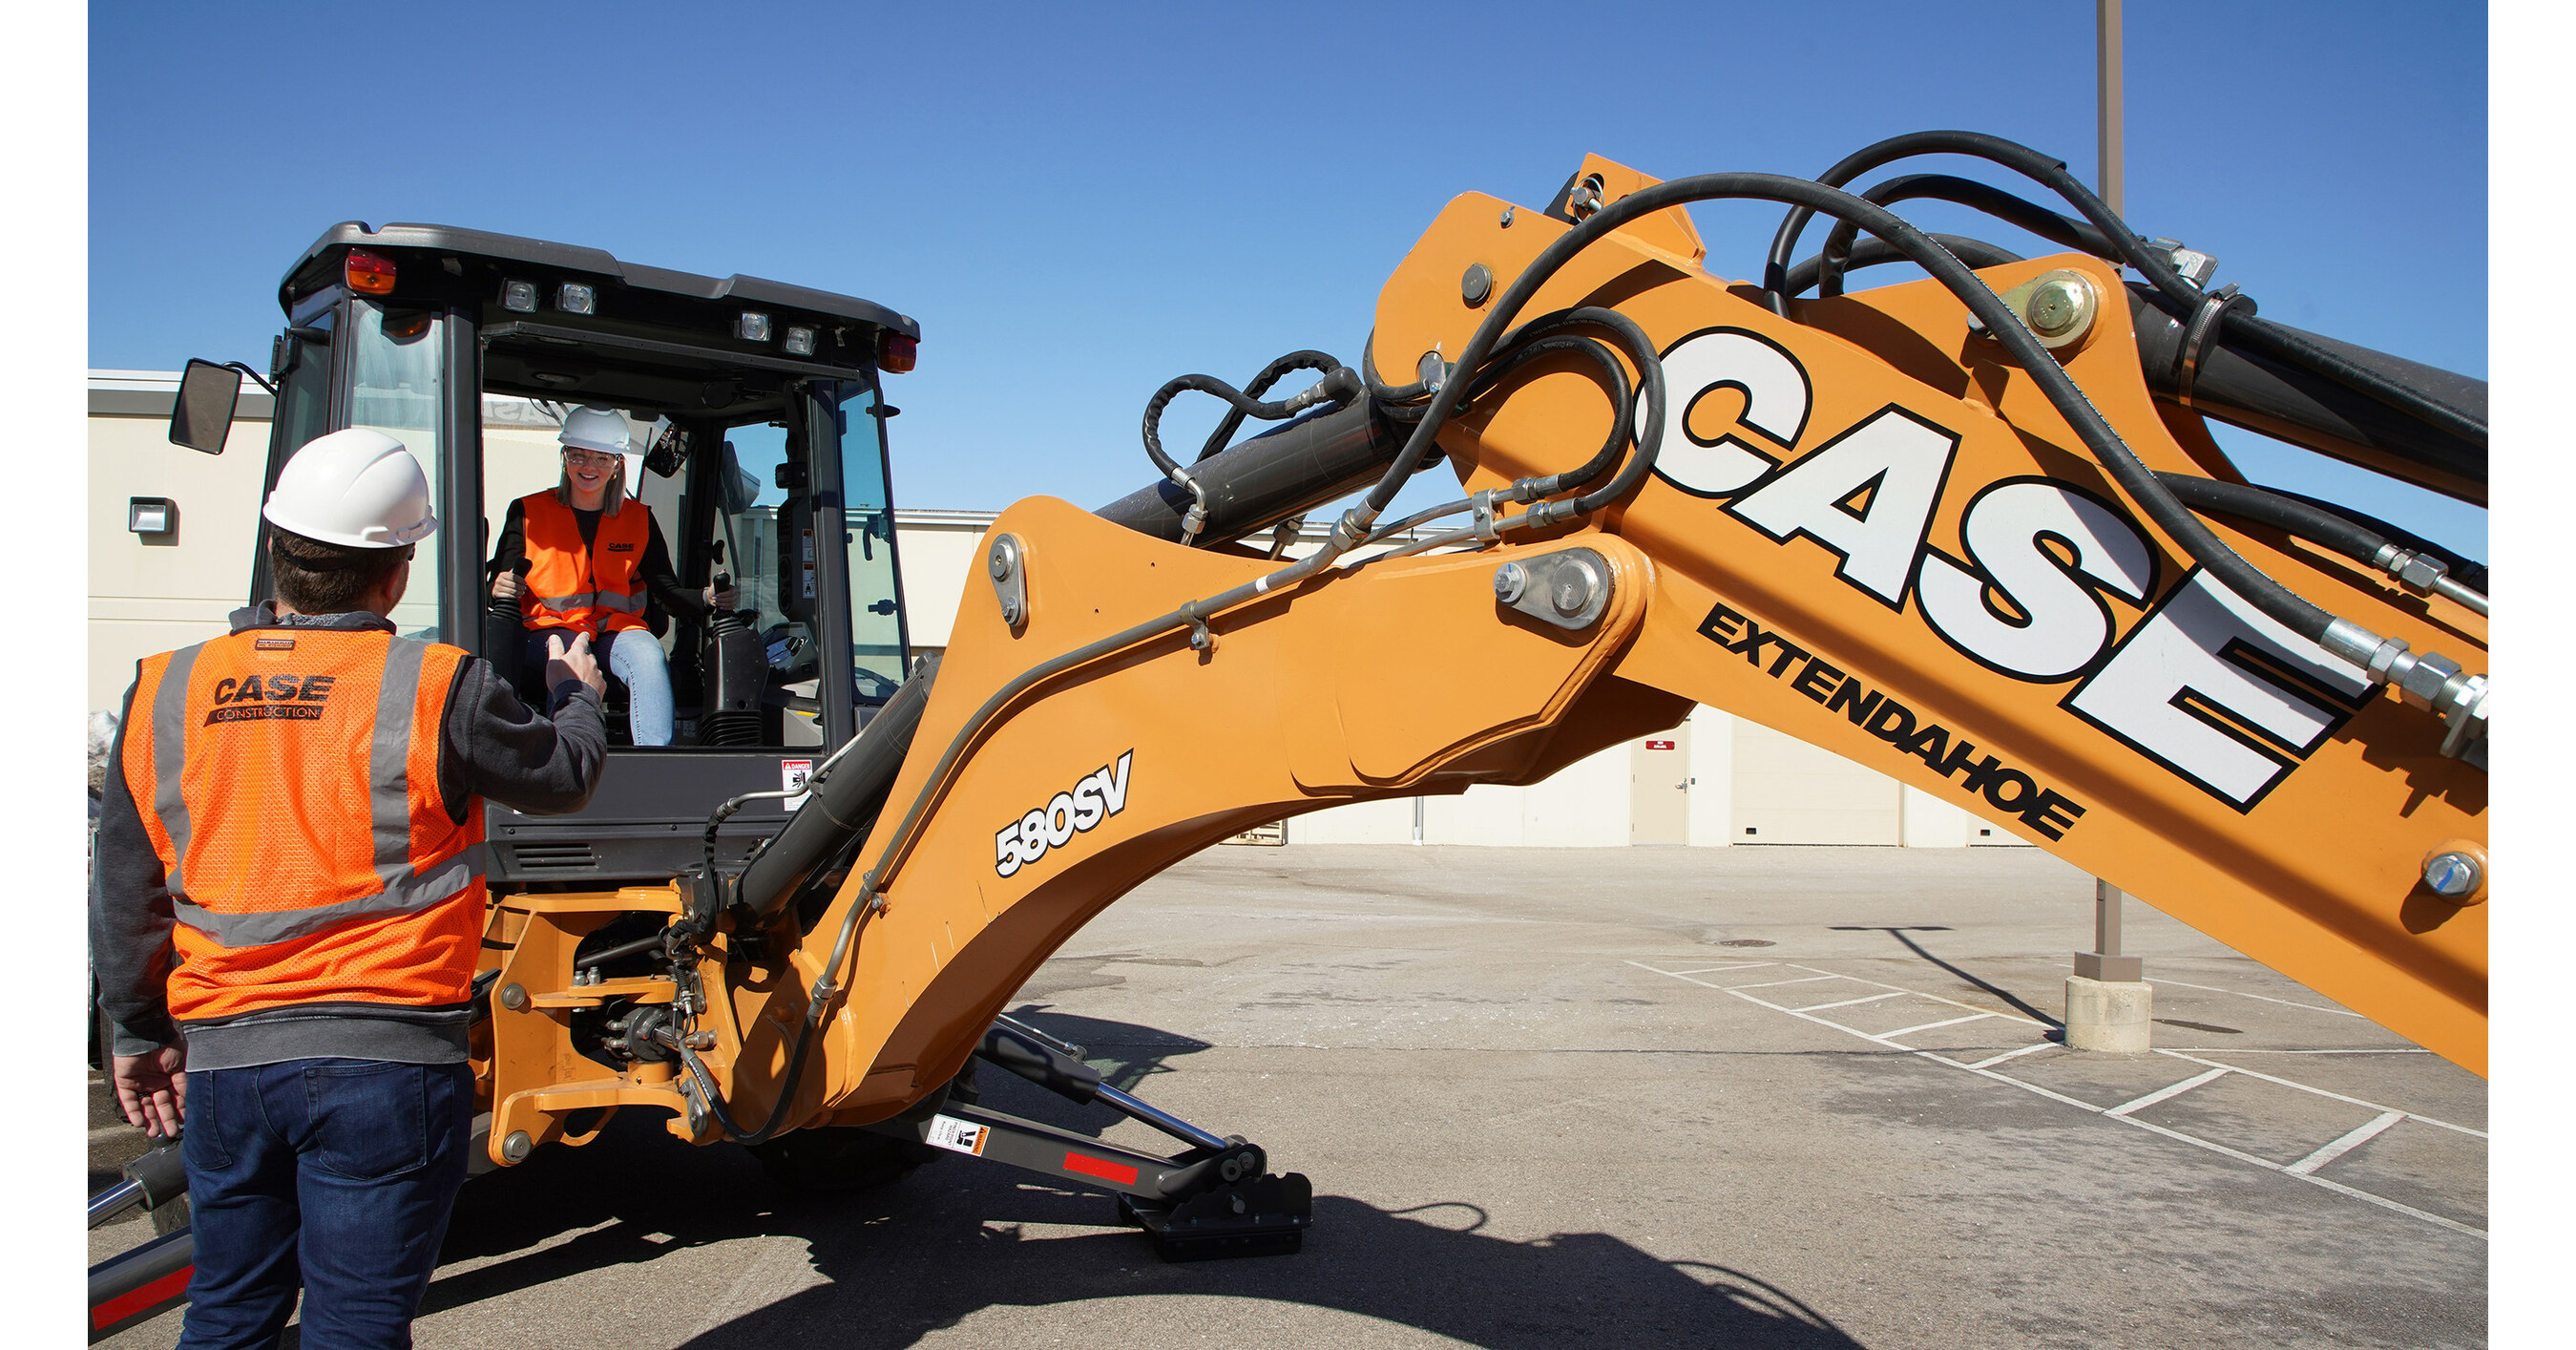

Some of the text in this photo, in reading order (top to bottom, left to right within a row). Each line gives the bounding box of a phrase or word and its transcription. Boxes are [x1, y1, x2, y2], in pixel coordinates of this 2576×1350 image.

[1630, 326, 2385, 814] CASE
[214, 674, 336, 706] CASE
[217, 707, 318, 721] CONSTRUCTION
[1697, 601, 2086, 842] EXTENDAHOE
[995, 748, 1134, 878] 580SV
